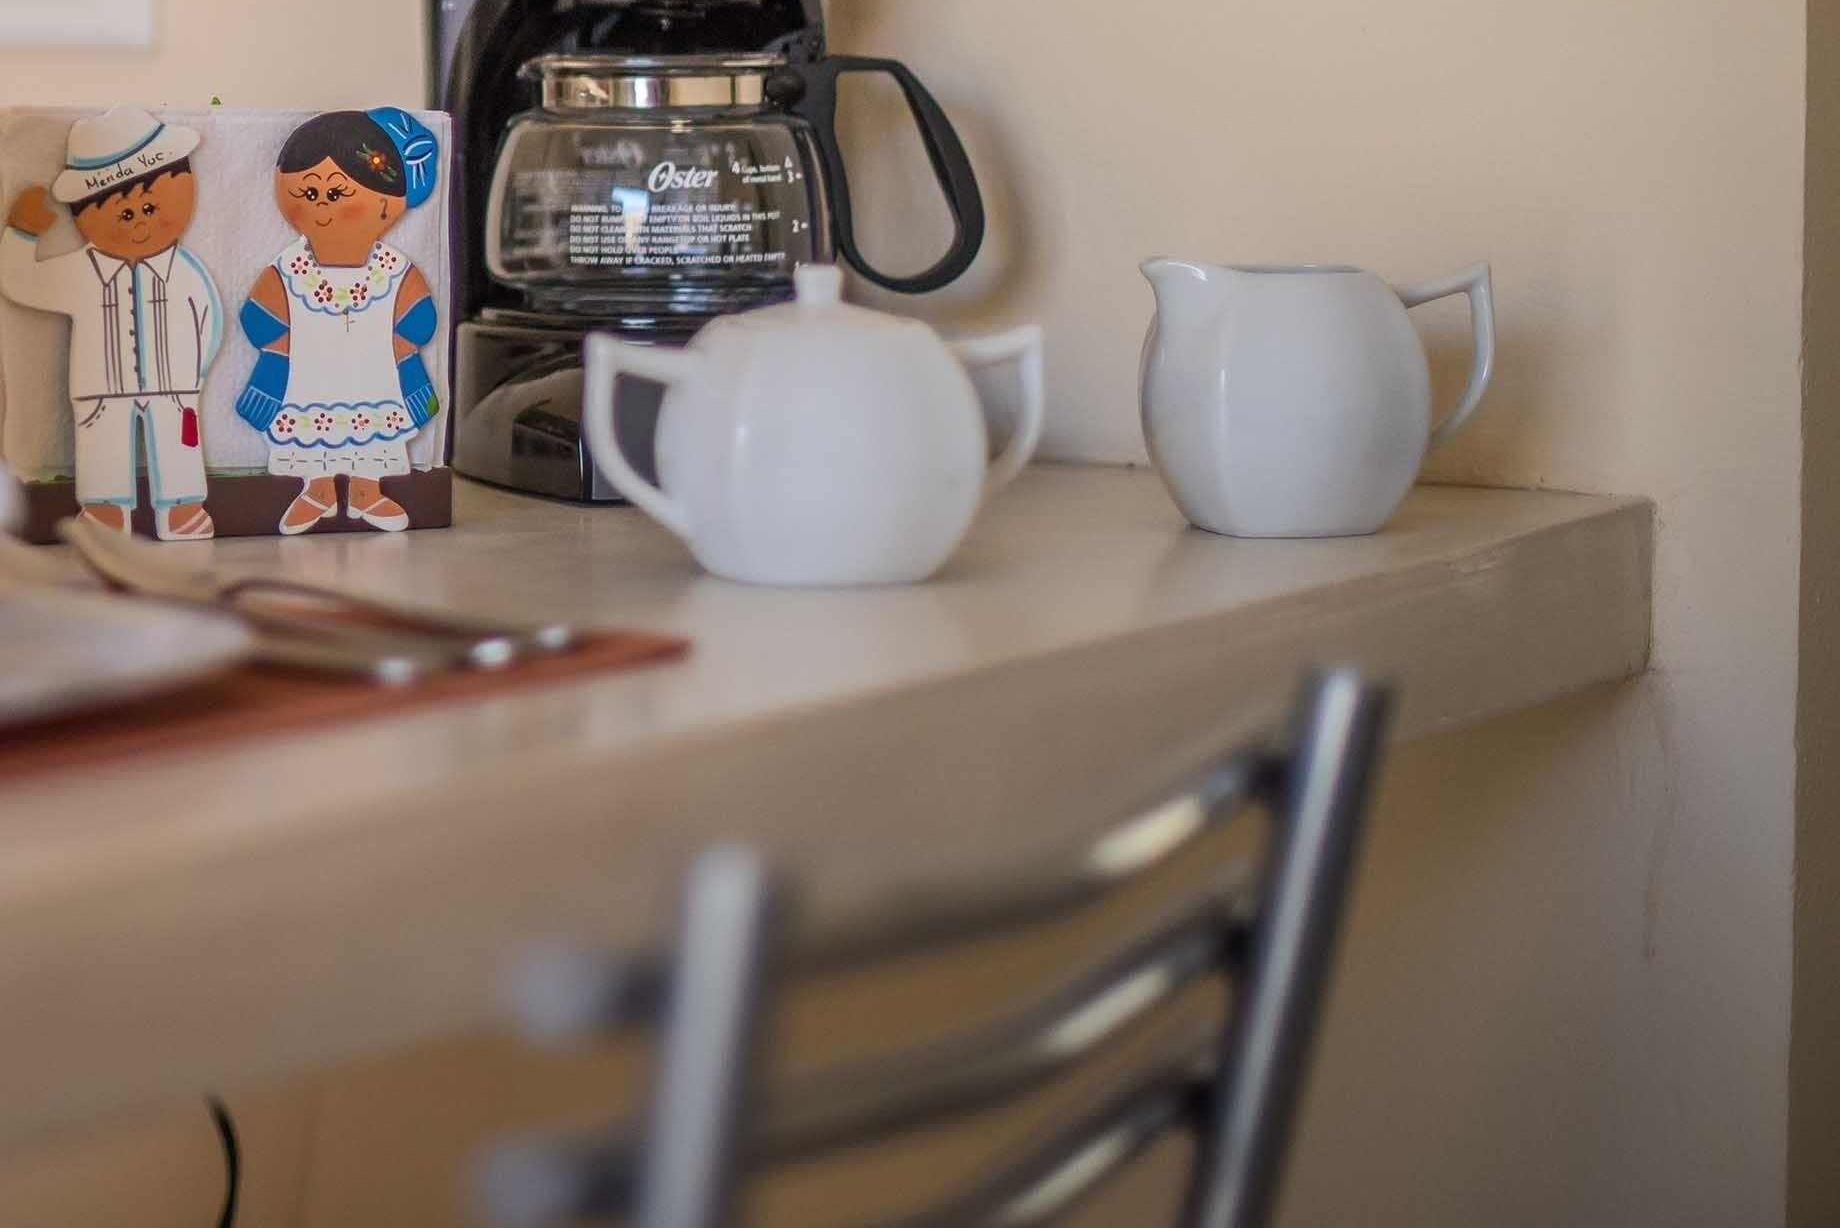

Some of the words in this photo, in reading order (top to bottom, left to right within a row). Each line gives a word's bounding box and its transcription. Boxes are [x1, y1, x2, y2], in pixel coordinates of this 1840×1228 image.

[648, 161, 718, 193] Oster
[570, 215, 581, 223] DO
[583, 215, 599, 223] NOT
[570, 225, 581, 233] DO
[583, 225, 599, 233] NOT
[720, 224, 752, 232] SCRATCH
[791, 219, 800, 233] 2
[570, 236, 581, 244] DO
[583, 236, 599, 244] NOT
[601, 236, 616, 244] USE
[711, 235, 726, 243] HOT
[728, 234, 750, 242] PLATE
[601, 246, 624, 254] HOLD
[570, 256, 598, 265] THROW
[600, 256, 624, 265] AWAY
[625, 256, 633, 265] IF
[676, 255, 722, 264] SCRATCHED
[723, 255, 734, 263] OR
[736, 254, 763, 262] HEATED
